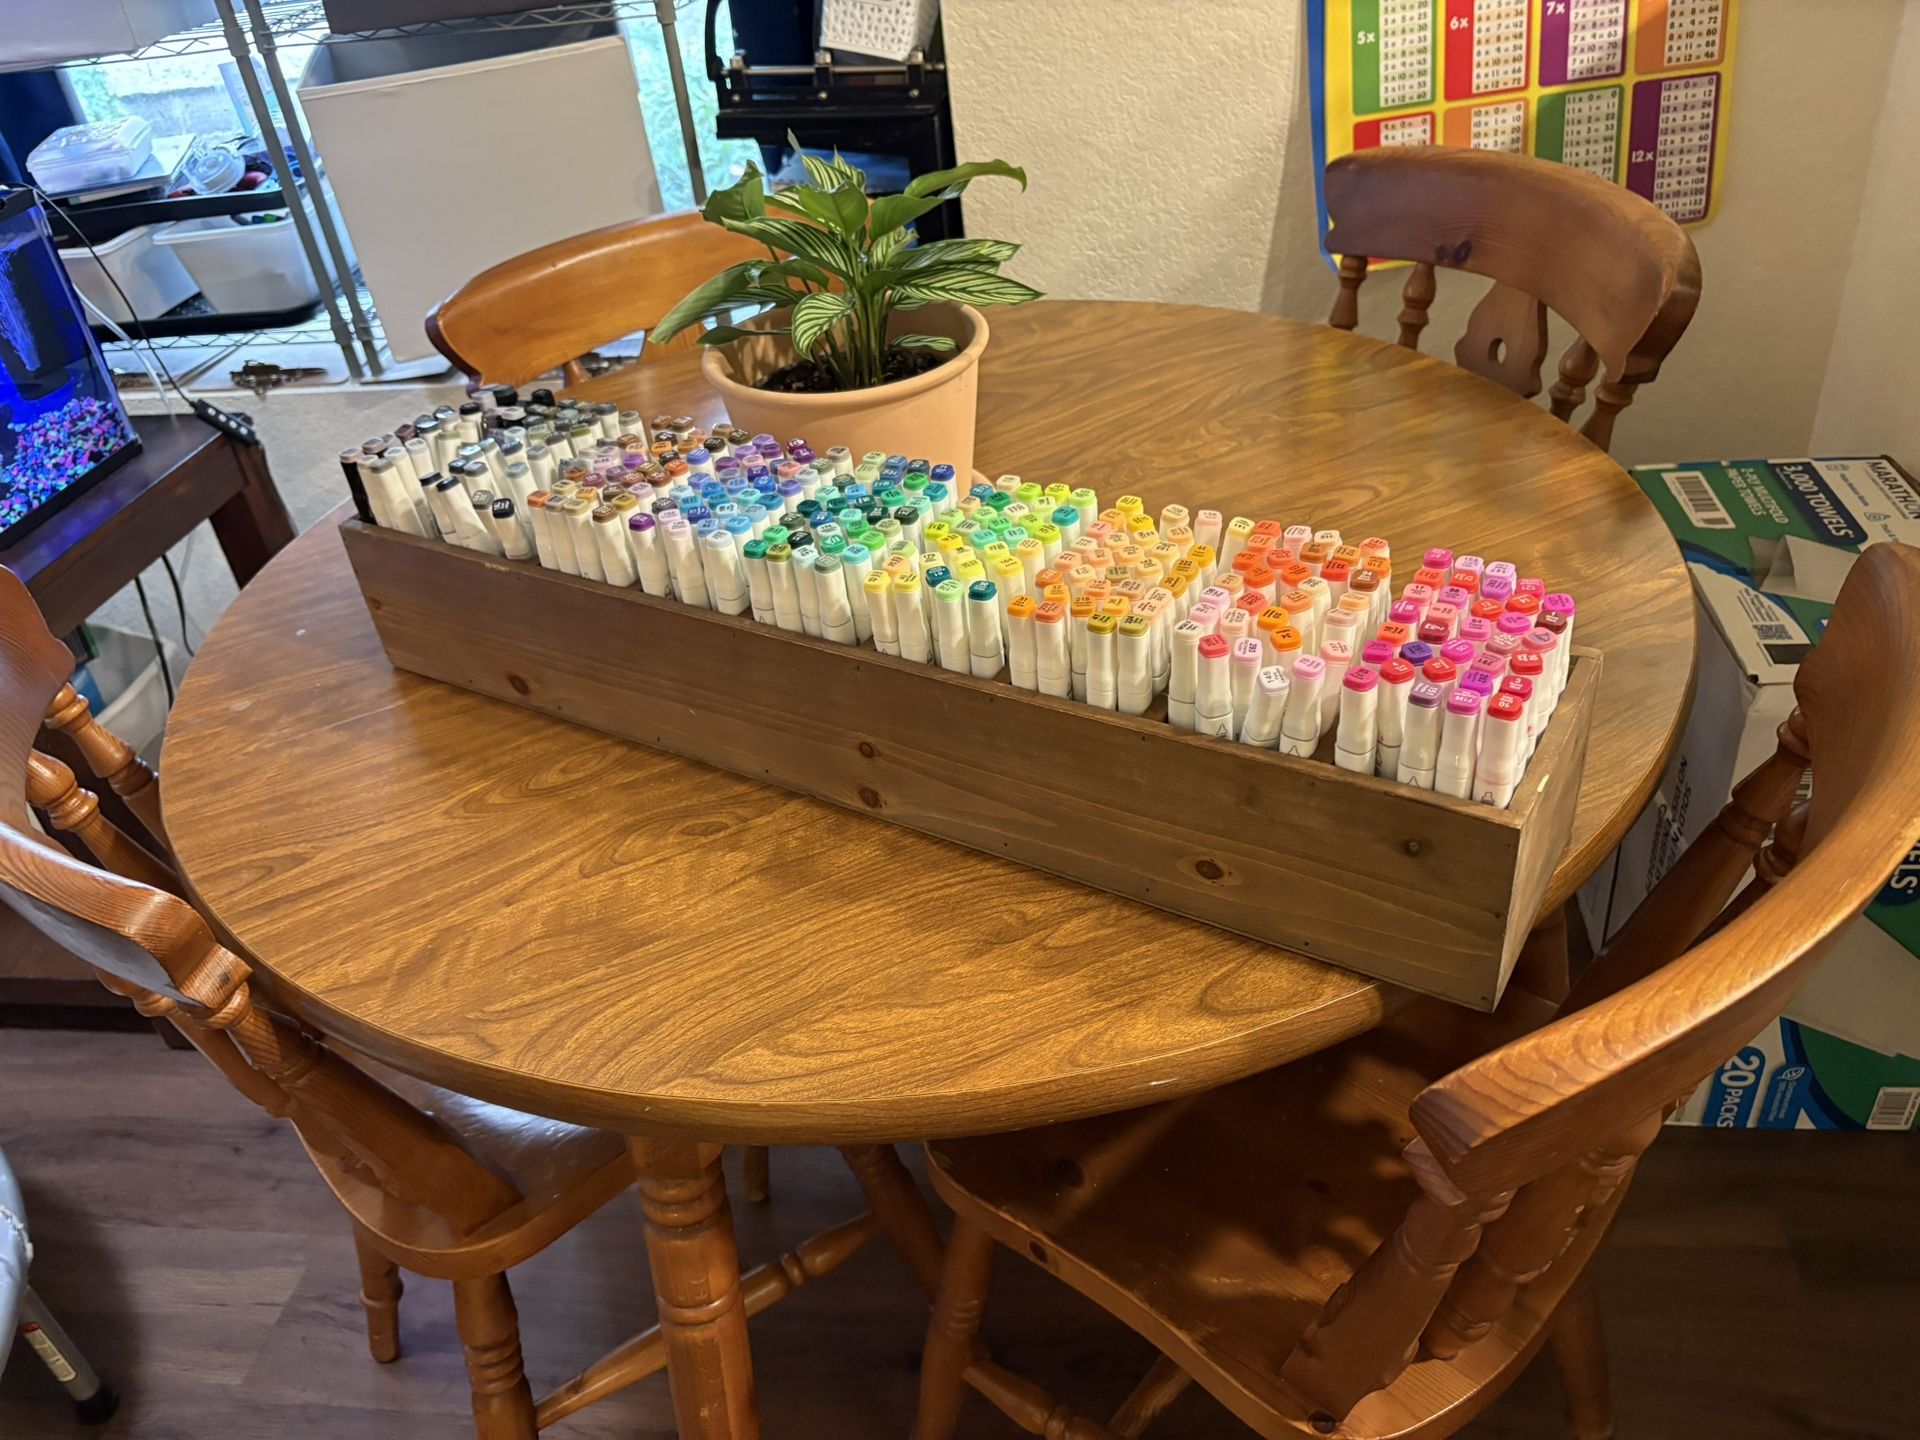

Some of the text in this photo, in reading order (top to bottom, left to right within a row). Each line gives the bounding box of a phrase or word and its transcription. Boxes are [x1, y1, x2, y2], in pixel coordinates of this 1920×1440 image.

[1450, 16, 1469, 30] 6x
[1357, 31, 1376, 45] 5x
[1632, 150, 1654, 163] 12x
[1783, 465, 1819, 492] 3,000
[1716, 1055, 1760, 1128] 20 PACKS
